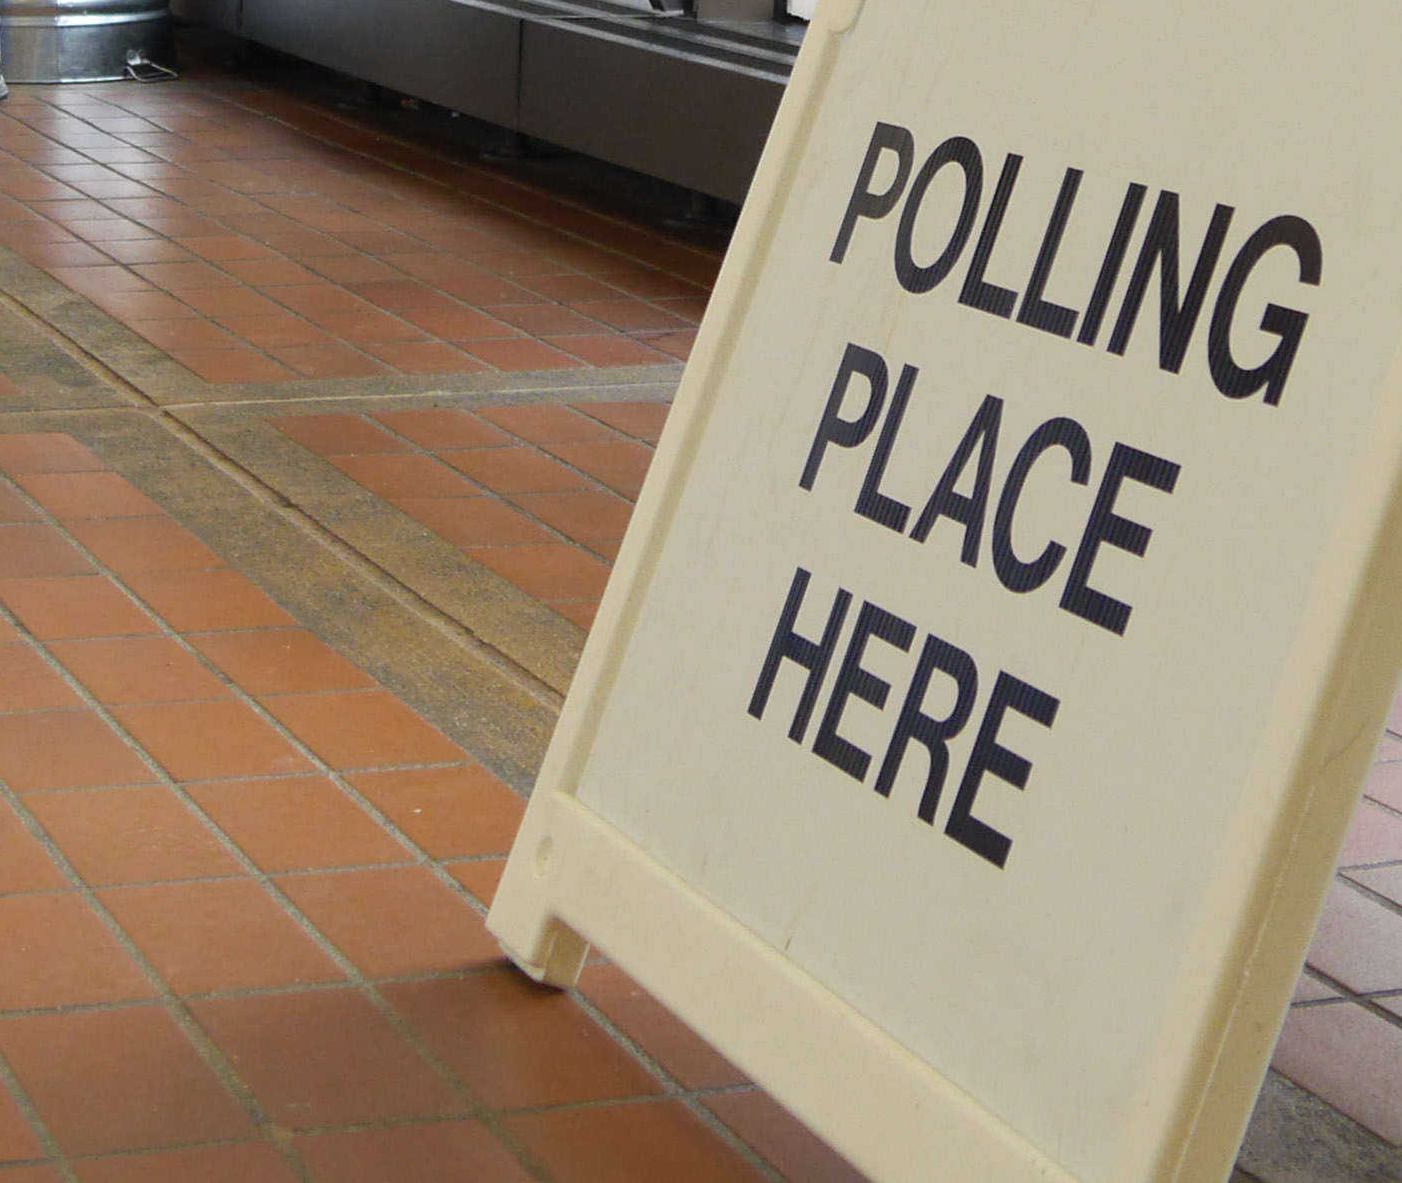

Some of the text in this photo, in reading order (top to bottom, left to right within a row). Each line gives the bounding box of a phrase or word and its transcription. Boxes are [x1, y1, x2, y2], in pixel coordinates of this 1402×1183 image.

[829, 121, 1323, 407] POLLING
[799, 342, 1182, 637] PLACE
[747, 566, 1061, 871] HERE
